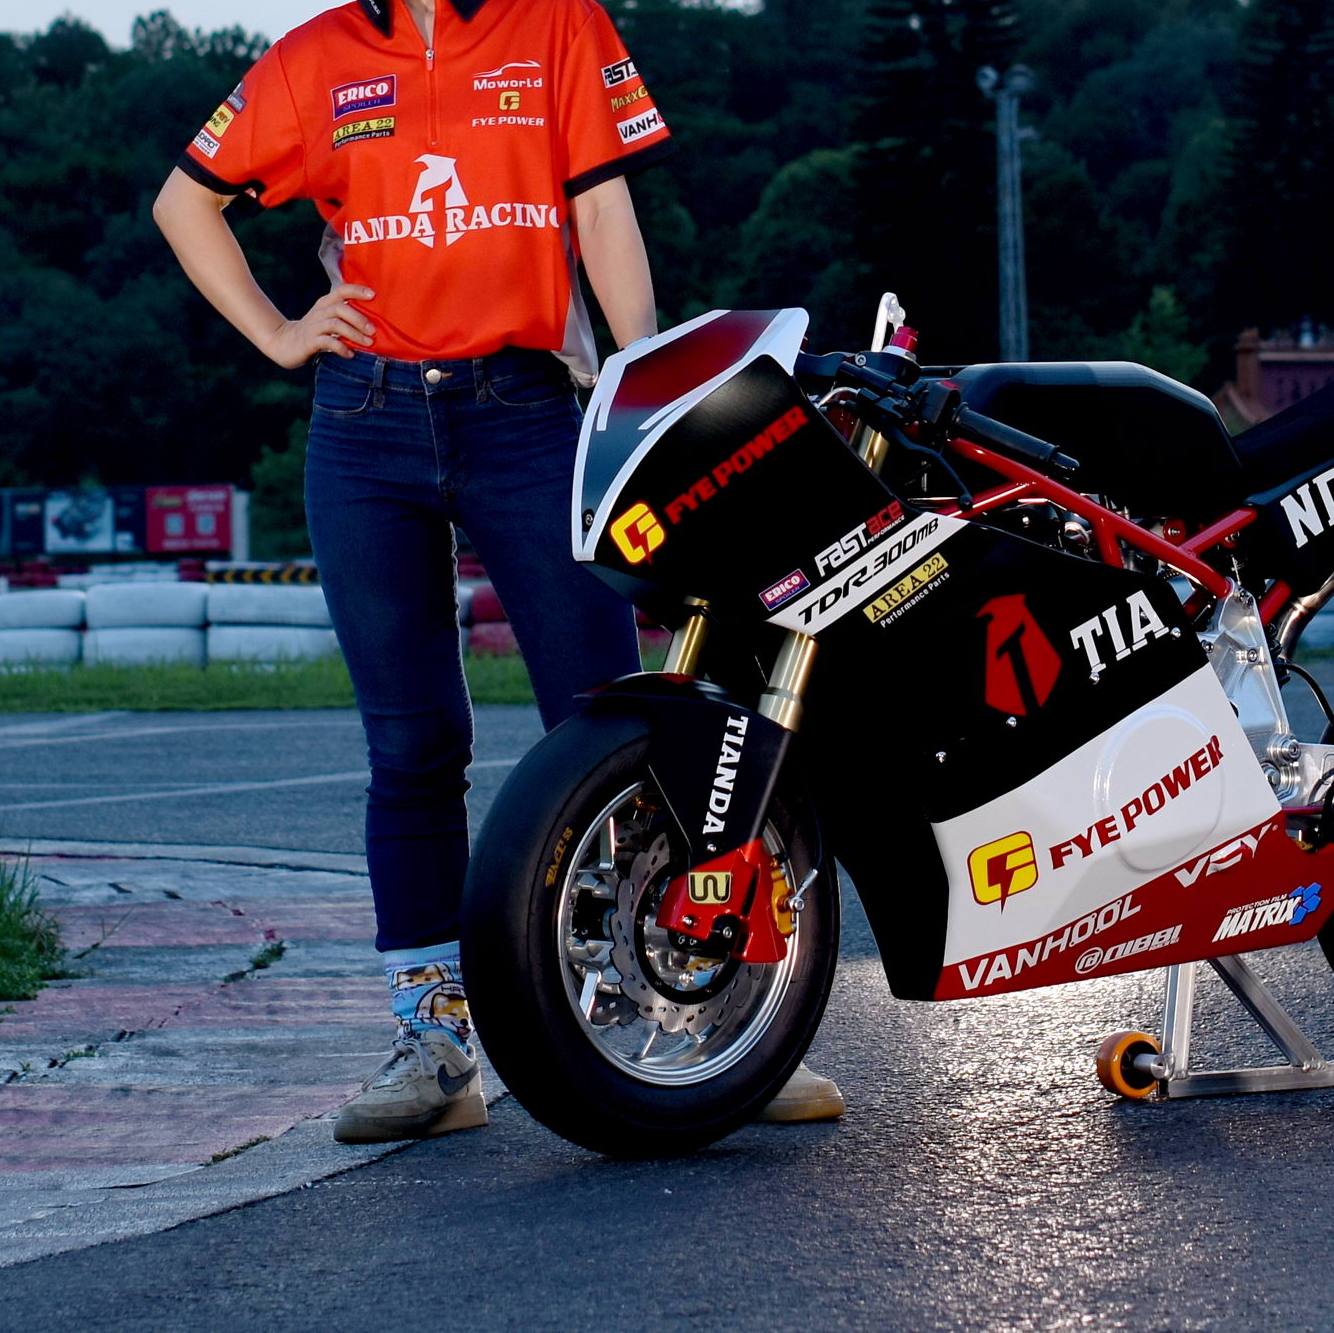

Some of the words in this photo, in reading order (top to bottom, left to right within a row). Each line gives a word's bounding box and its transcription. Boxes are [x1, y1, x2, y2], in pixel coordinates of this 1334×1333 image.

[338, 82, 389, 106] ERICO
[473, 77, 543, 91] Moworld
[334, 121, 373, 142] AREA
[376, 118, 392, 129] 22
[472, 117, 496, 128] FYE
[498, 116, 545, 127] POWER
[663, 475, 717, 525] FYE
[711, 405, 809, 488] POWER
[764, 575, 801, 602] ERICO
[871, 574, 926, 621] AREA
[922, 556, 945, 579] 22
[880, 588, 929, 628] Performance
[927, 571, 950, 591] Parts
[1069, 589, 1170, 673] TIA
[702, 715, 749, 835] TIANDA
[1048, 814, 1121, 870] FYE
[1119, 734, 1224, 834] POWER
[1211, 896, 1302, 944] MATRIX
[1226, 897, 1271, 916] PROTECTION
[1270, 893, 1288, 904] FILM
[957, 894, 1142, 991] VANHOOL
